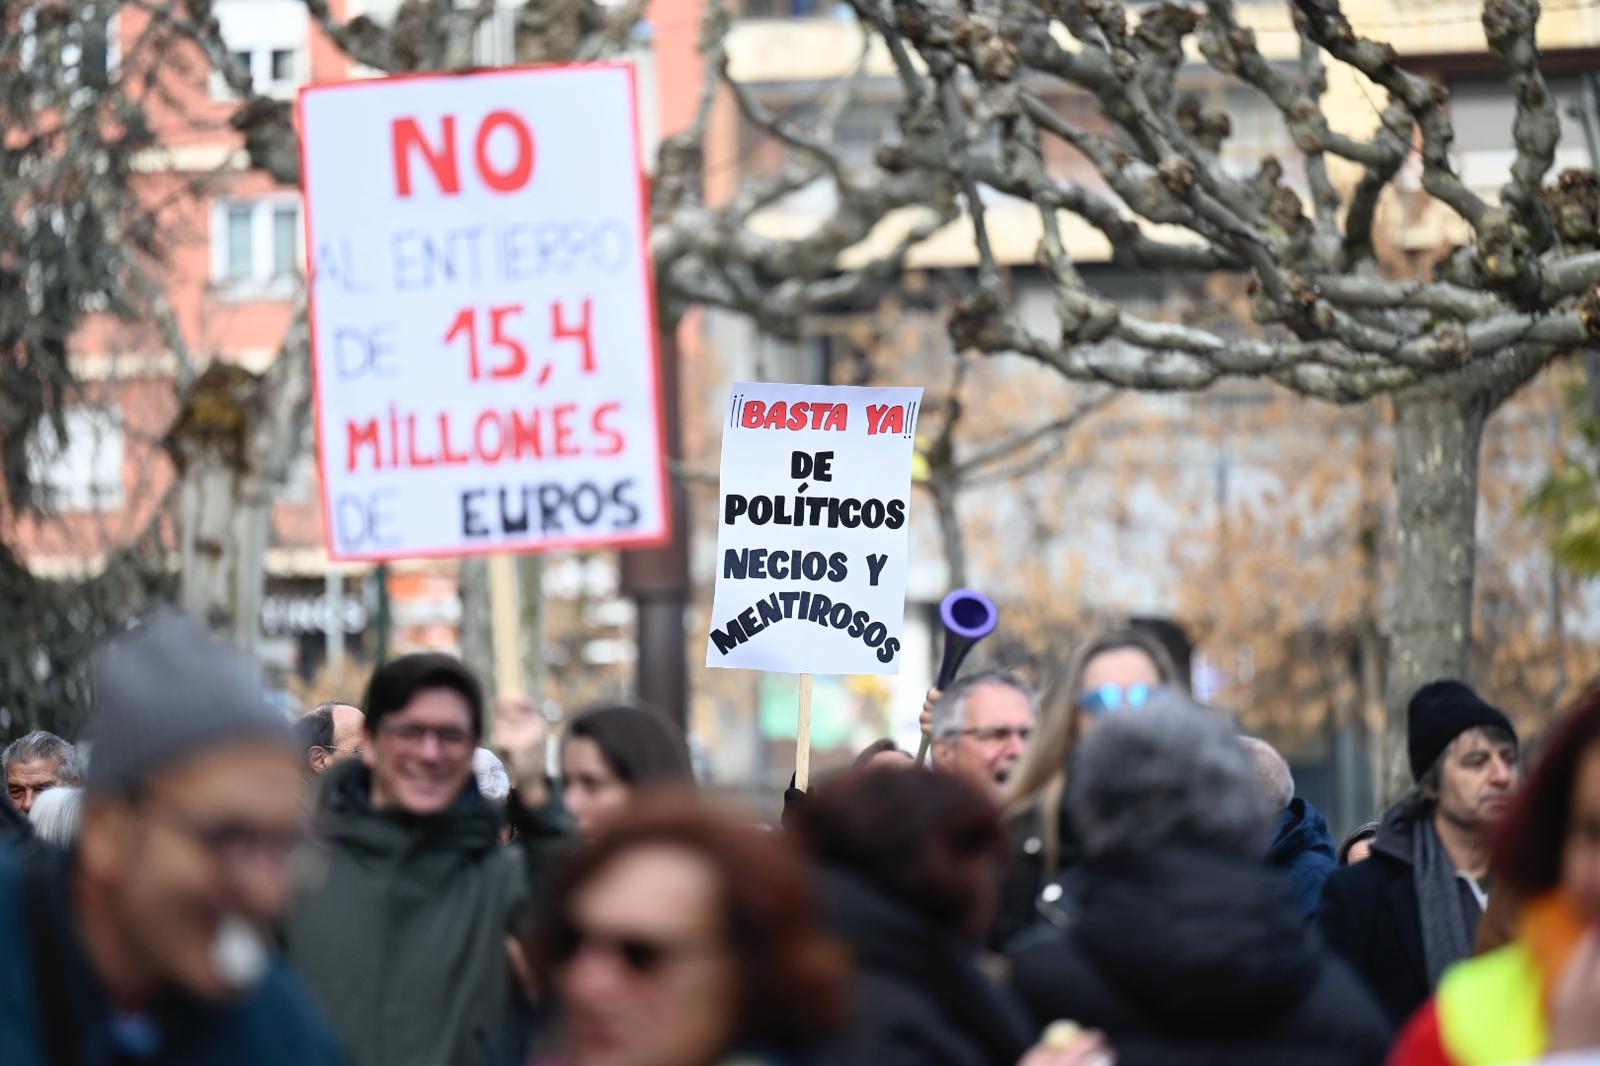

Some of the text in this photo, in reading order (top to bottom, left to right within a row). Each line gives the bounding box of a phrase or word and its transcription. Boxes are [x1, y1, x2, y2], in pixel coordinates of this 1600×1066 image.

[390, 109, 534, 196] NO
[314, 230, 371, 296] AL
[332, 298, 597, 385] DE 15,4
[791, 450, 835, 482] DE
[334, 478, 640, 549] DE EUROS
[724, 482, 906, 529] POLÍTICOS
[723, 548, 889, 586] NECIOS Y
[709, 591, 901, 664] MENTIROSOS
